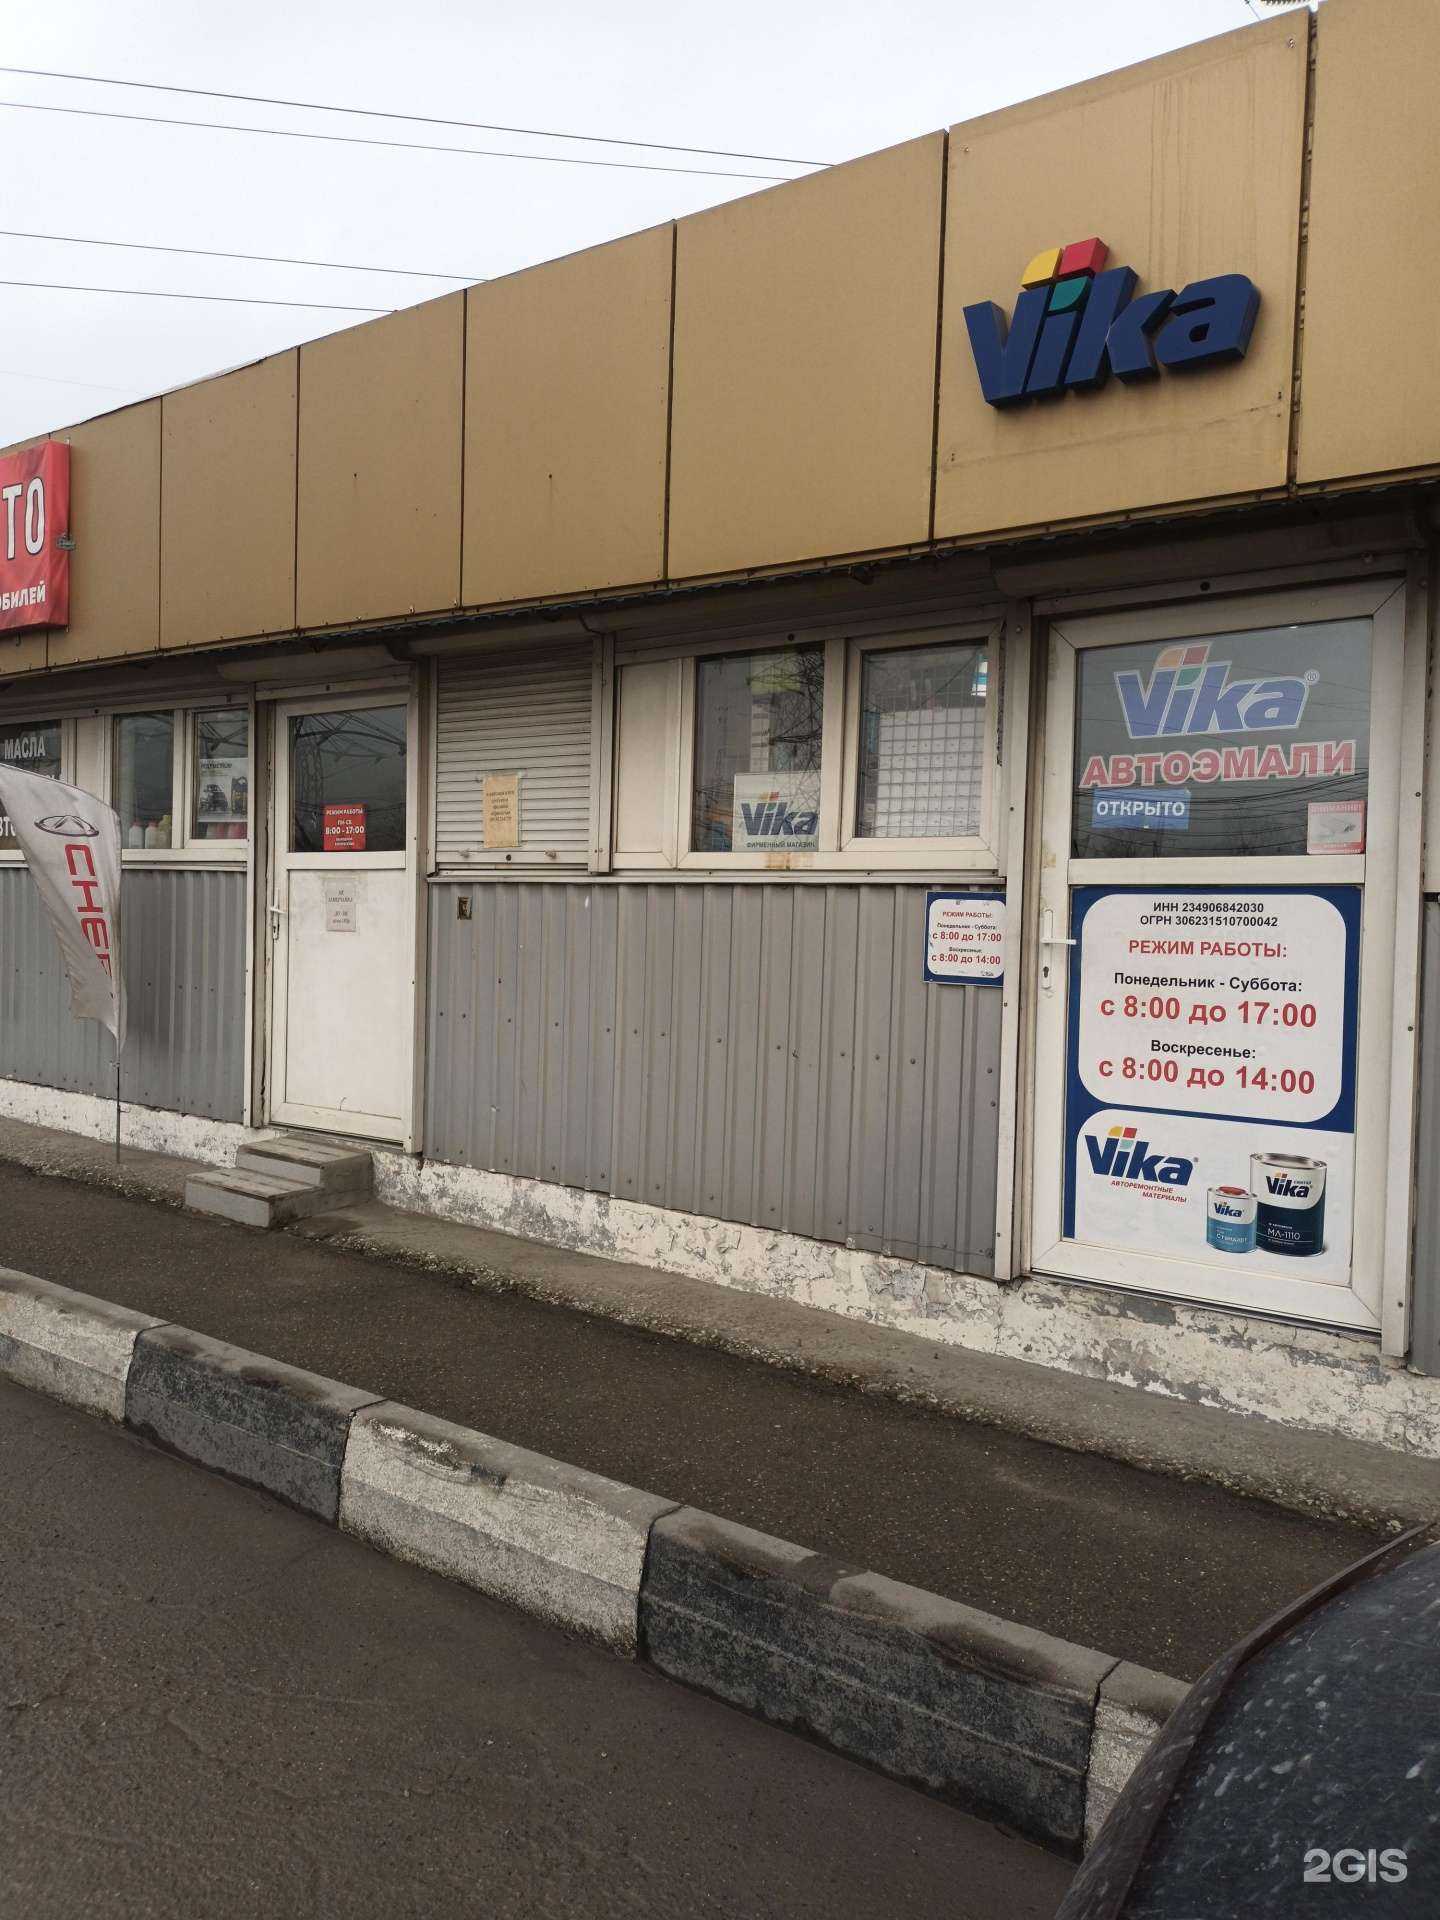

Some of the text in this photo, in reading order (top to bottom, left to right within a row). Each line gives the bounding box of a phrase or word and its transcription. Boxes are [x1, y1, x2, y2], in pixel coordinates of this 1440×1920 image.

[962, 236, 1261, 410] Vika
[0, 580, 46, 611] БИЛЕЙ
[1114, 641, 1310, 740] Vika
[4, 736, 46, 760] МАСЛА
[1078, 739, 1357, 789] АВТОЭМАЛИ
[740, 791, 819, 836] Vika
[1096, 799, 1186, 818] ОТКРЫТО
[1153, 902, 1264, 913] ИНН 234906842030
[1140, 915, 1278, 927] ОГРН 306231510700042
[977, 932, 1002, 942] 17:00
[960, 957, 973, 965] до
[976, 955, 1001, 965] 14:00
[1128, 940, 1288, 958] РЕЖИМ РАБОТЫ:
[1114, 972, 1215, 989] Понедельник
[1229, 977, 1302, 993] Суббота:
[1100, 995, 1317, 1028] с 8:00 до 17:00
[1150, 1039, 1256, 1059] Воскресенье:
[1099, 1056, 1315, 1095] с 8:00 до 14:00
[1084, 1125, 1194, 1187] Vika
[1110, 1179, 1174, 1194] АВТОРЕМОНТНЫЕ
[1265, 1173, 1310, 1198] Vika
[1142, 1191, 1187, 1204] МАТЕРИАЛЫ
